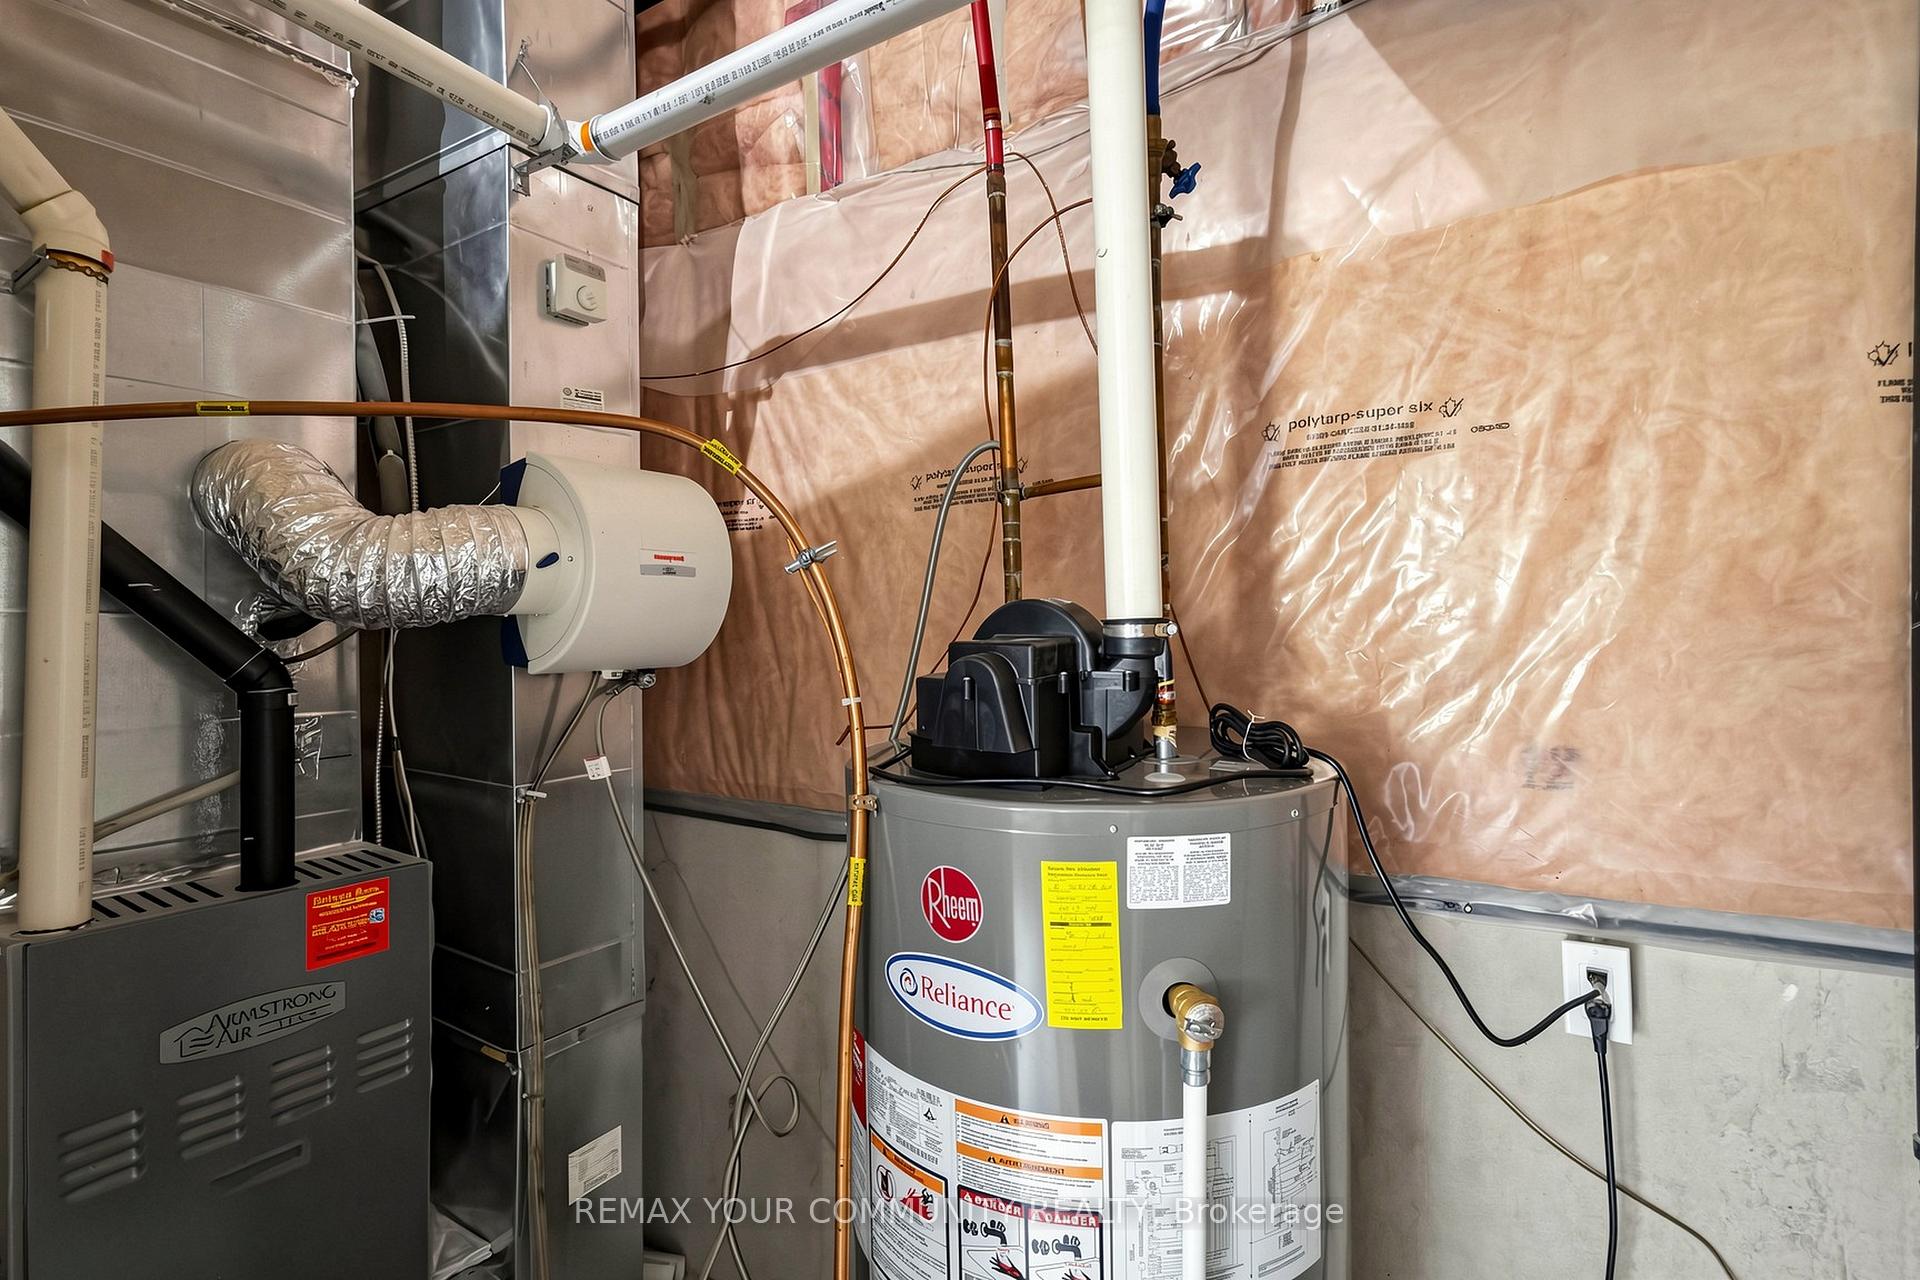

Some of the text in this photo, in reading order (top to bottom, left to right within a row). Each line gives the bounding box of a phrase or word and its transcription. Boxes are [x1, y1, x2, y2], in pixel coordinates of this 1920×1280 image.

[928, 867, 979, 929] Rheem
[204, 984, 337, 1034] ARMSTRONG
[921, 976, 1012, 1021] Reliance
